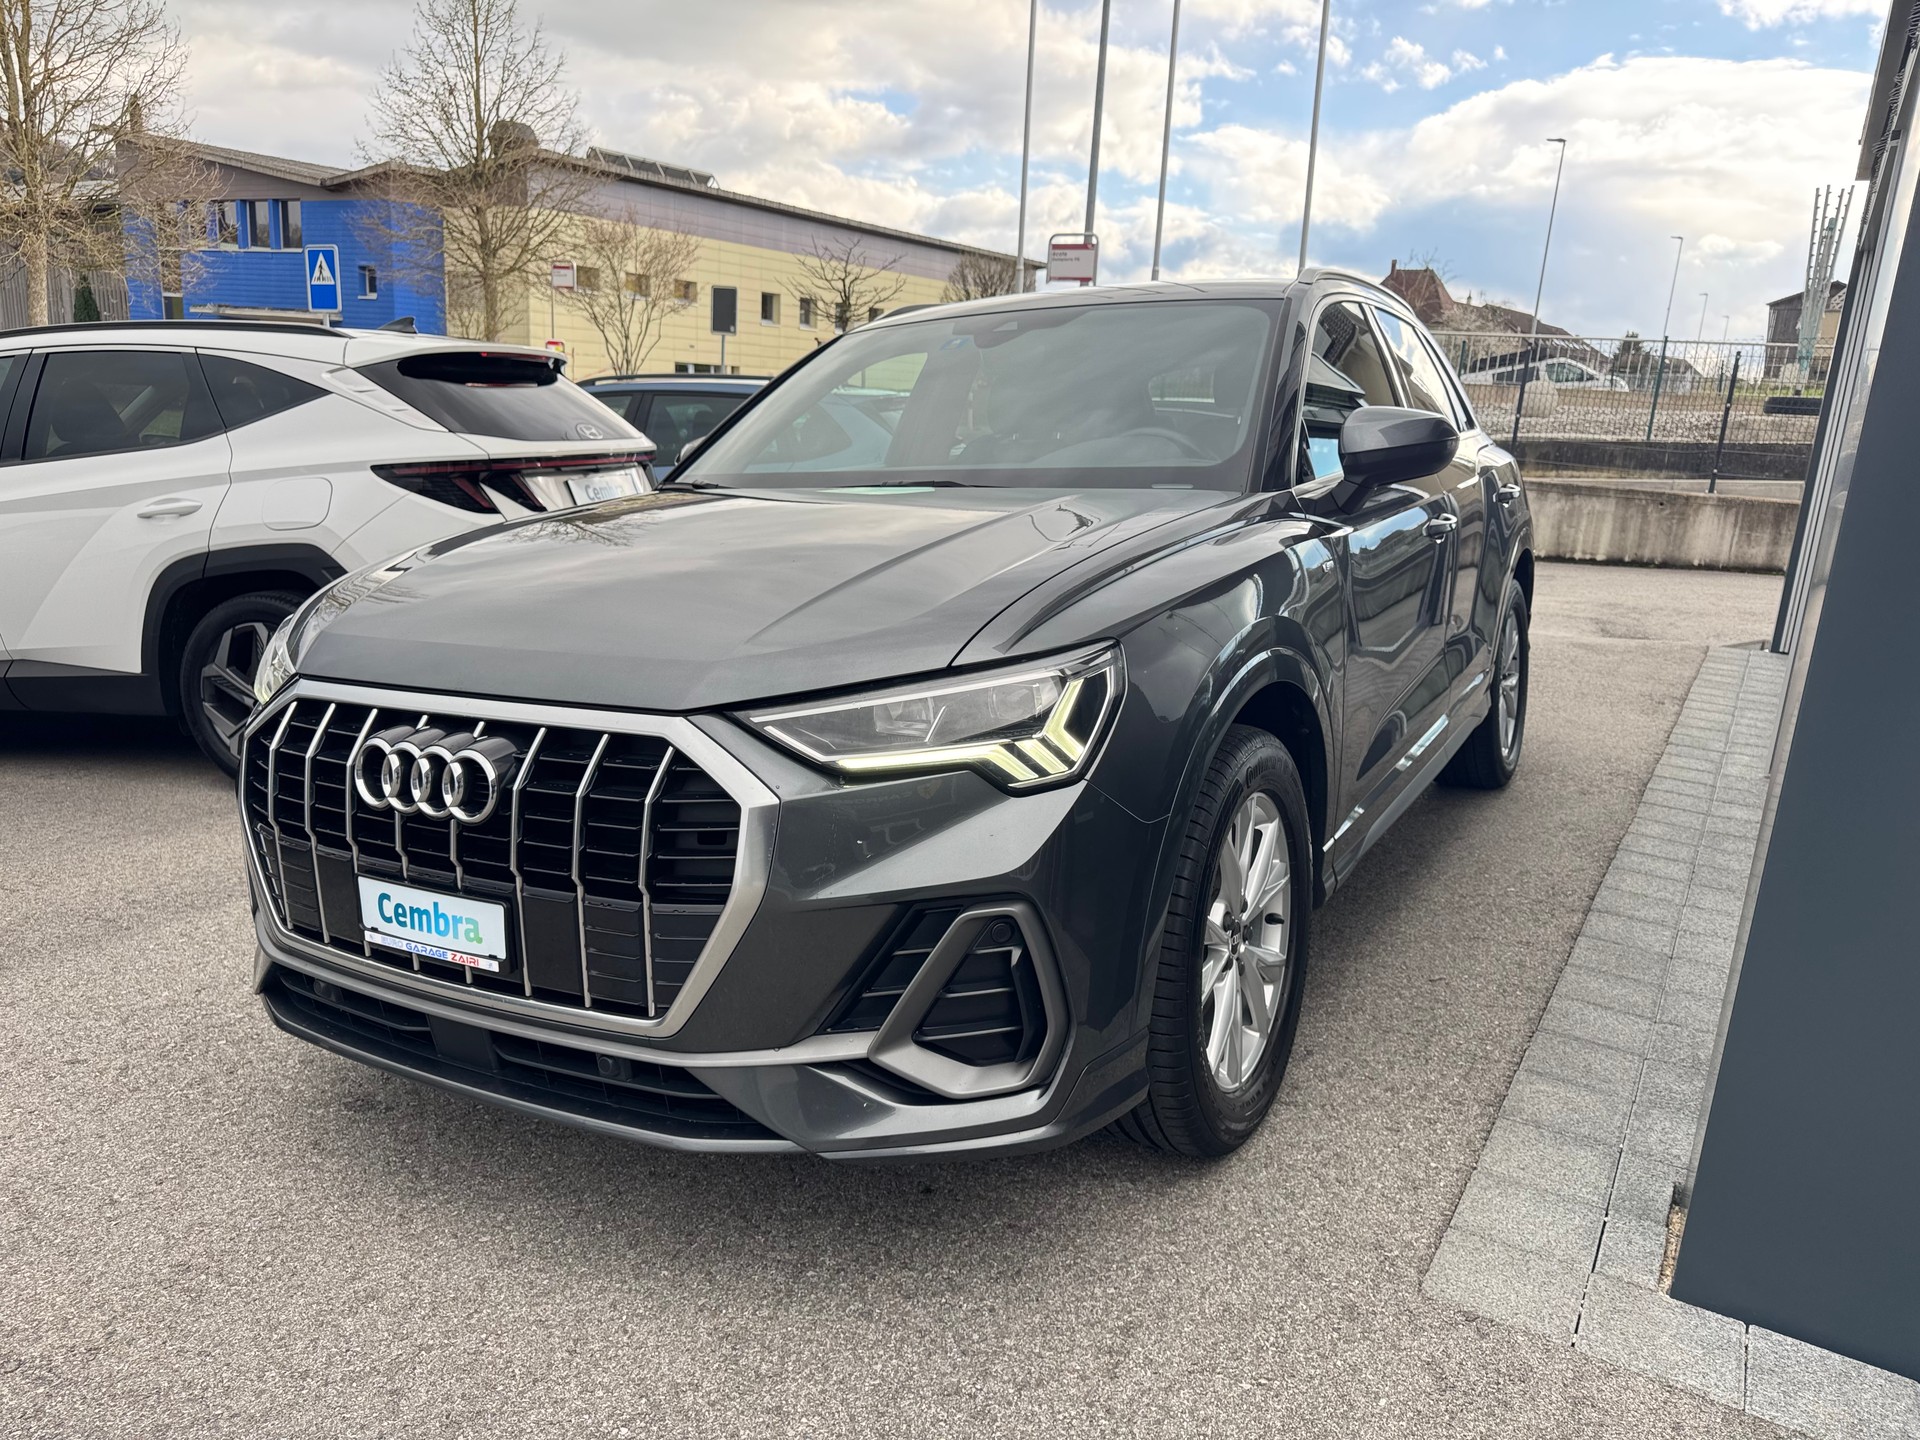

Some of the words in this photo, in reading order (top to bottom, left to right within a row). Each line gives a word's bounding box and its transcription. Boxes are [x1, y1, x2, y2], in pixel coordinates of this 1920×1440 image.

[584, 480, 625, 501] Cemba
[377, 892, 483, 944] Cembra
[405, 942, 449, 960] GARAGE
[450, 952, 480, 967] ZAIRI
